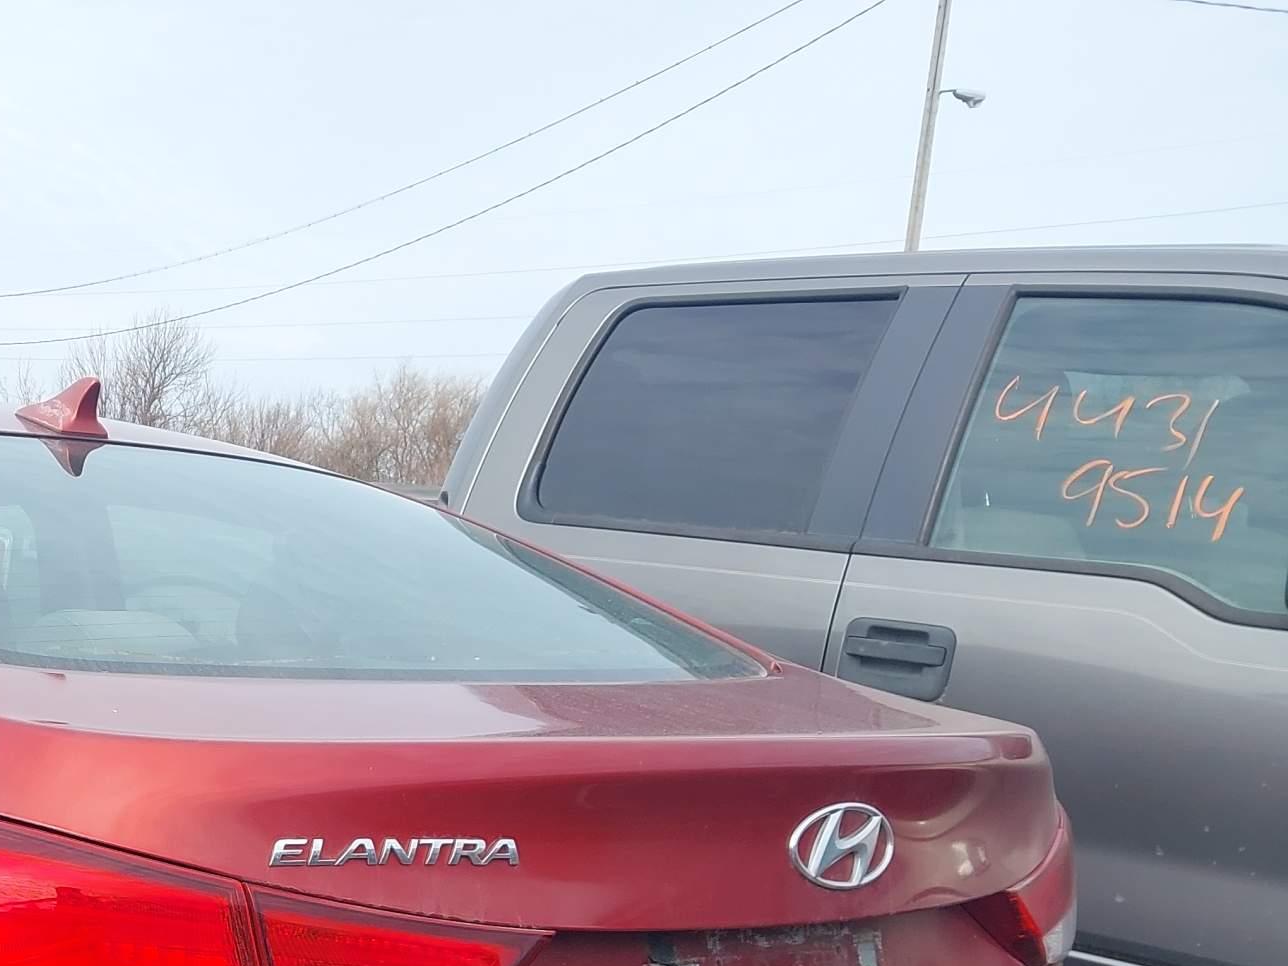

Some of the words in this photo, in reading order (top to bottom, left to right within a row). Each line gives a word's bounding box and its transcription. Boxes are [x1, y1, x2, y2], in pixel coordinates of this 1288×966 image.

[995, 375, 1220, 471] 4431
[1061, 458, 1244, 541] 9514
[269, 837, 520, 866] ELANTRA
